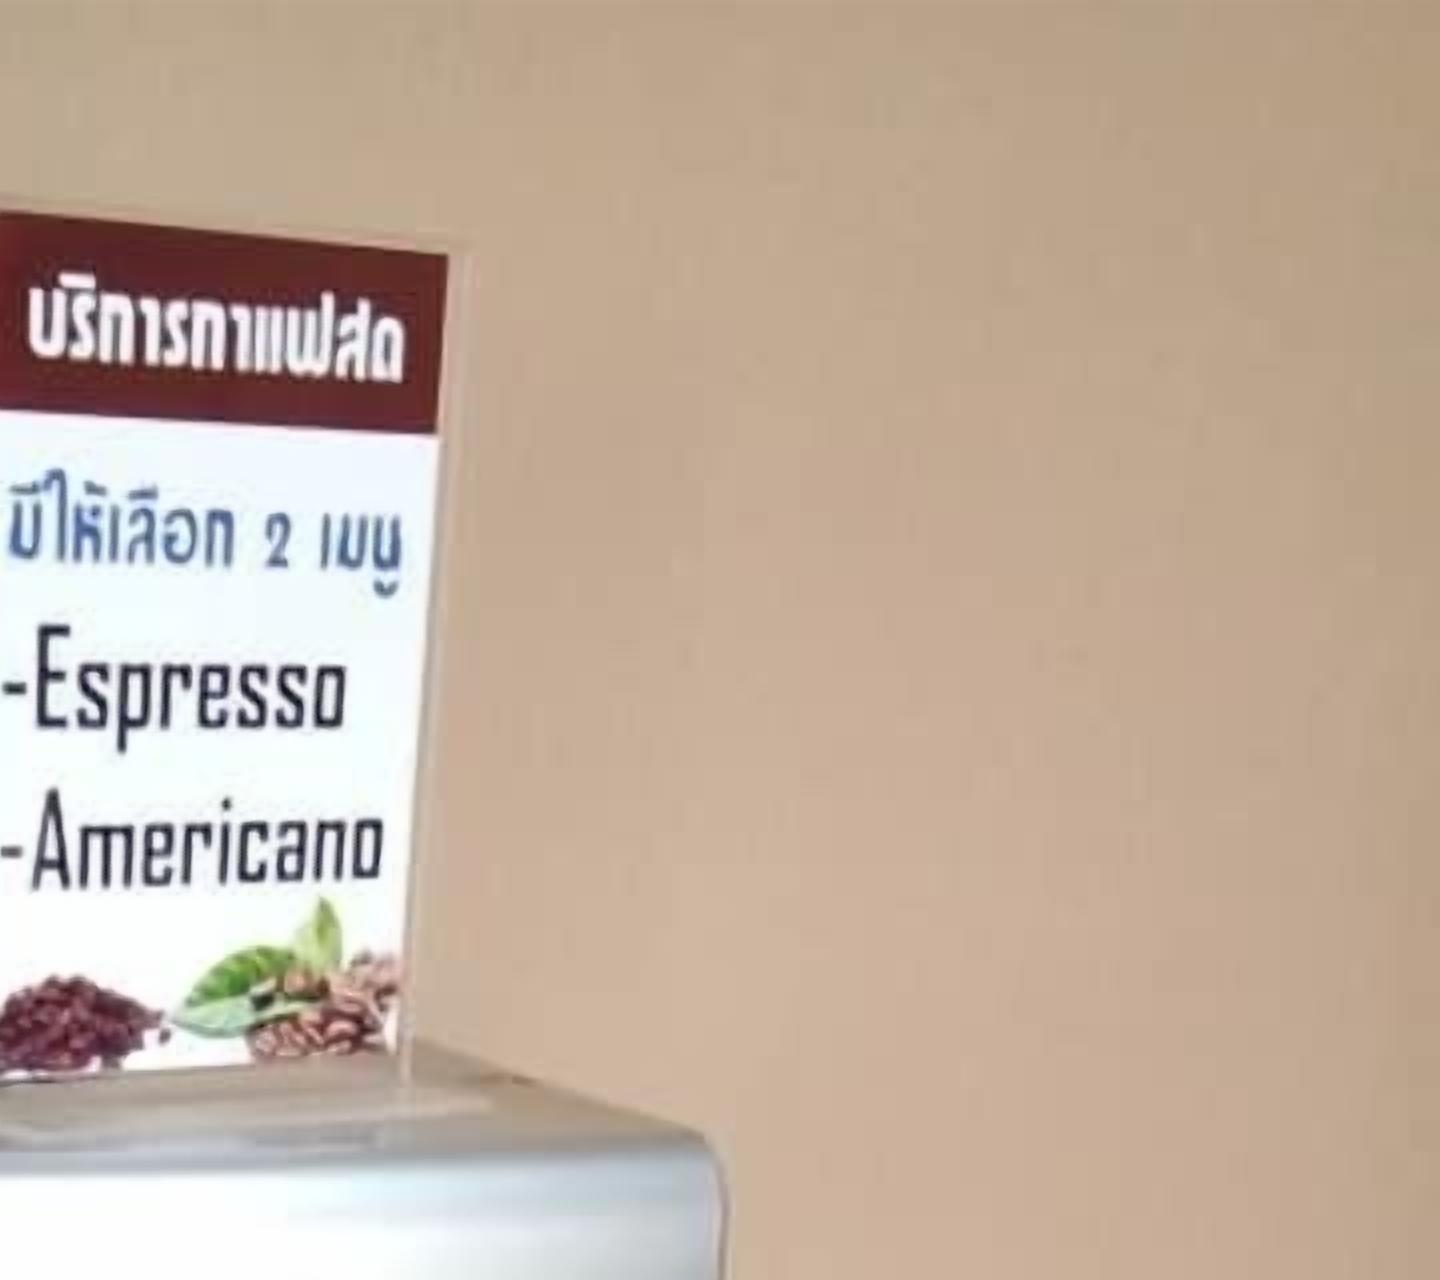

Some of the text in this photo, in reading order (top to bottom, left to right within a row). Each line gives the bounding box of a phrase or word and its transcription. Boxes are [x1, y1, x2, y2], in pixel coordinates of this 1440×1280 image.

[28, 272, 406, 384] บริการกาแฟสด
[8, 468, 402, 599] มีให้เลือก 2 เมนู
[1, 623, 347, 754] -Espresso
[0, 786, 384, 892] -Americano
